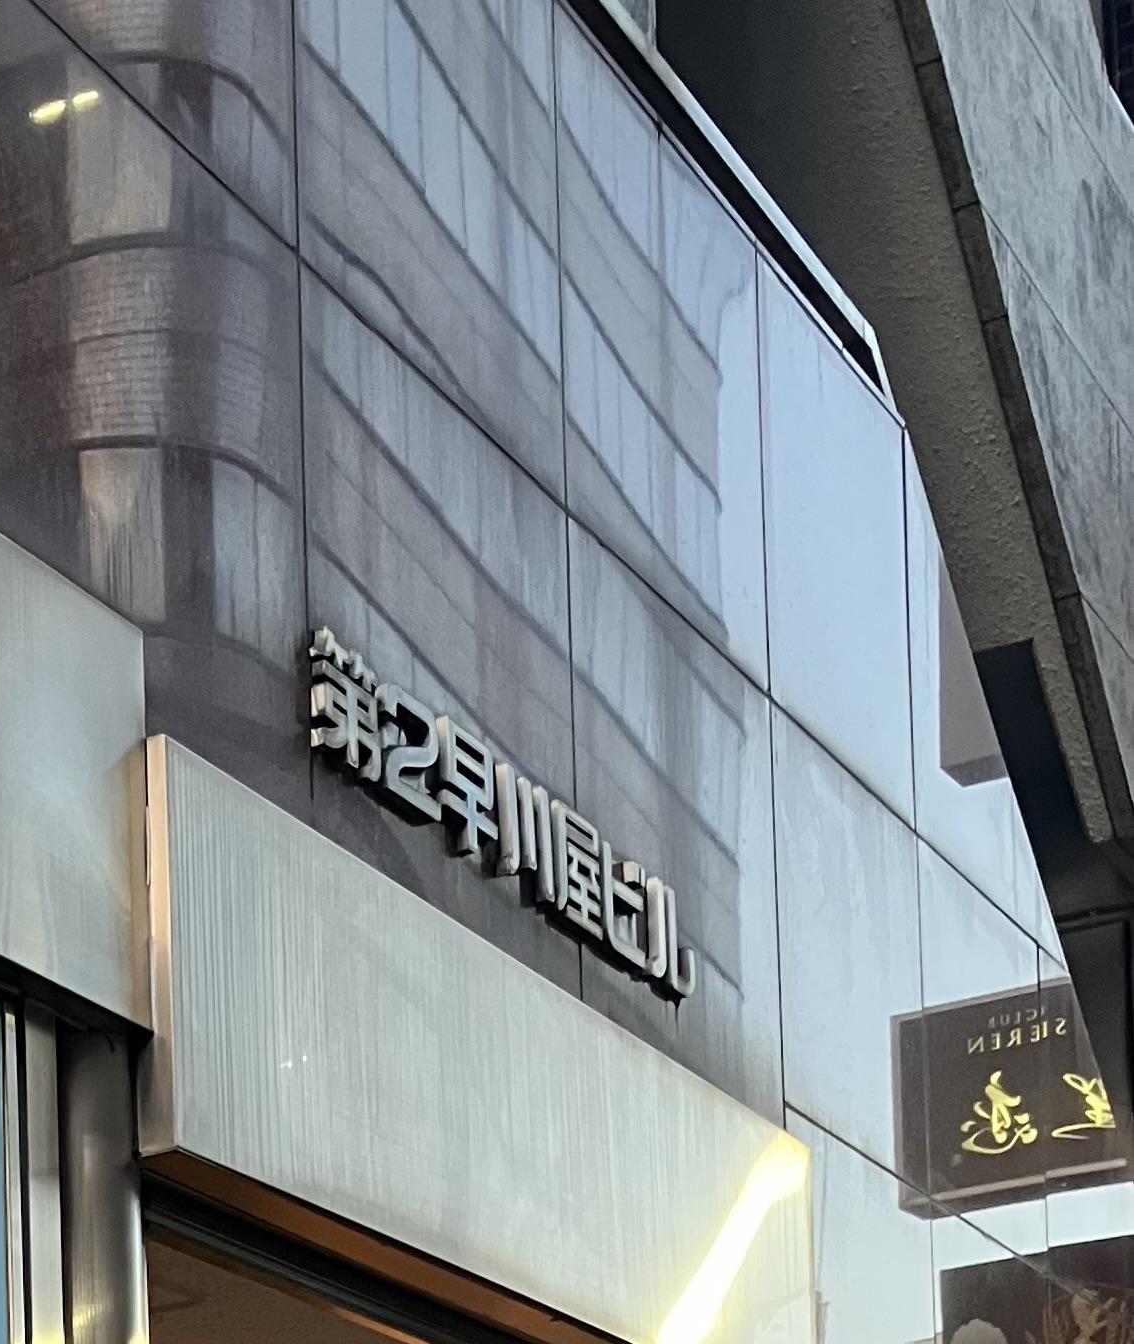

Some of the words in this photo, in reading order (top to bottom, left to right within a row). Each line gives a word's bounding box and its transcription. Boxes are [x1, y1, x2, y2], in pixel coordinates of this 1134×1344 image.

[309, 625, 696, 999] 第2早川屋ビル
